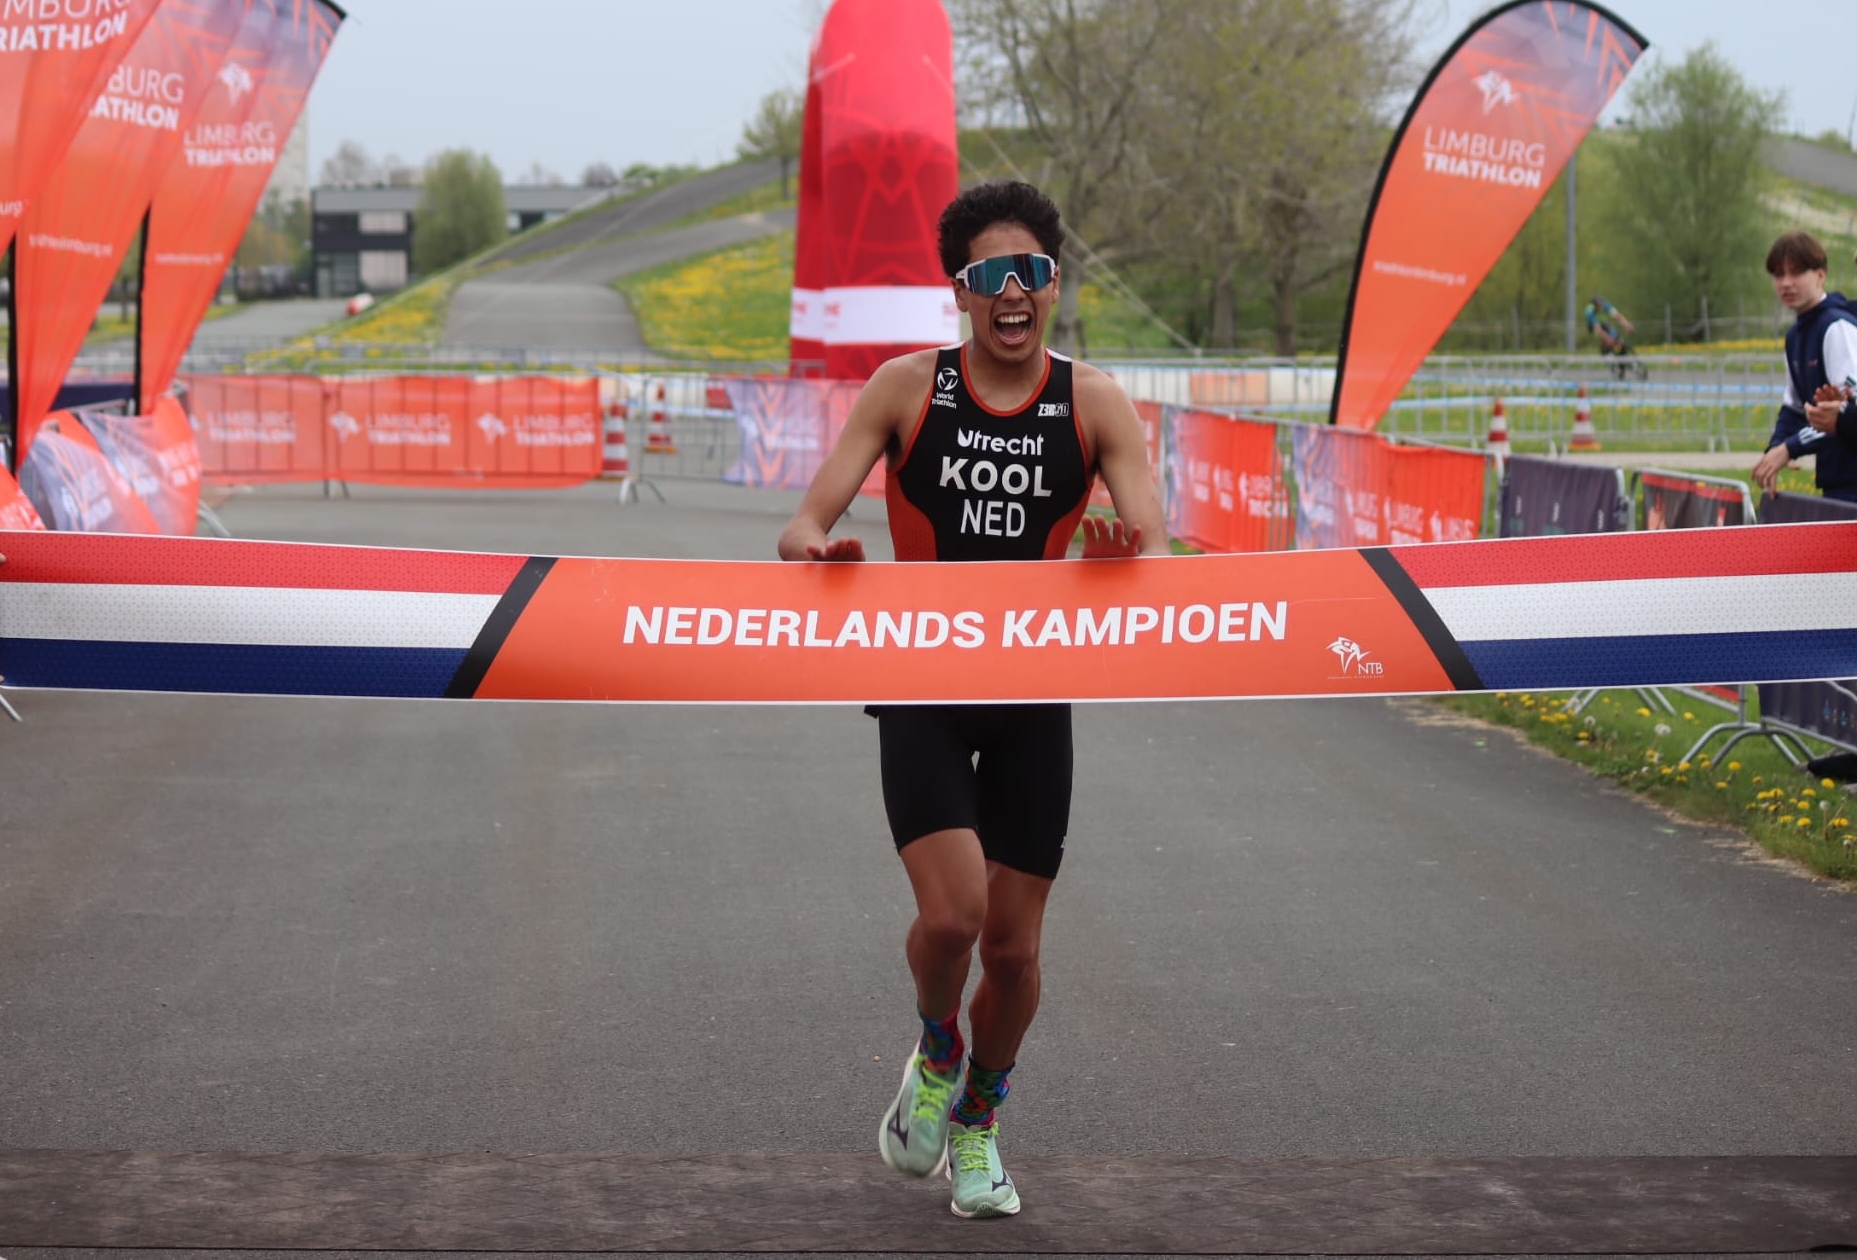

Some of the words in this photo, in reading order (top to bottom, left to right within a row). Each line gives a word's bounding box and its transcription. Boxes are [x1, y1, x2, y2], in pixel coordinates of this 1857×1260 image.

[90, 94, 179, 130] ATHLON
[183, 121, 276, 146] LIMBRG
[1424, 126, 1545, 167] LIMBURG
[1422, 152, 1542, 189] TRIATHLON
[931, 398, 957, 409] Triathlon
[936, 391, 955, 401] World
[957, 427, 1044, 455] Utrecht
[939, 455, 1052, 497] KOOL
[960, 499, 1026, 537] NED
[623, 606, 985, 648] NEDERLANDS
[1002, 601, 1288, 648] KAMPIOEN
[1358, 662, 1383, 675] NTB
